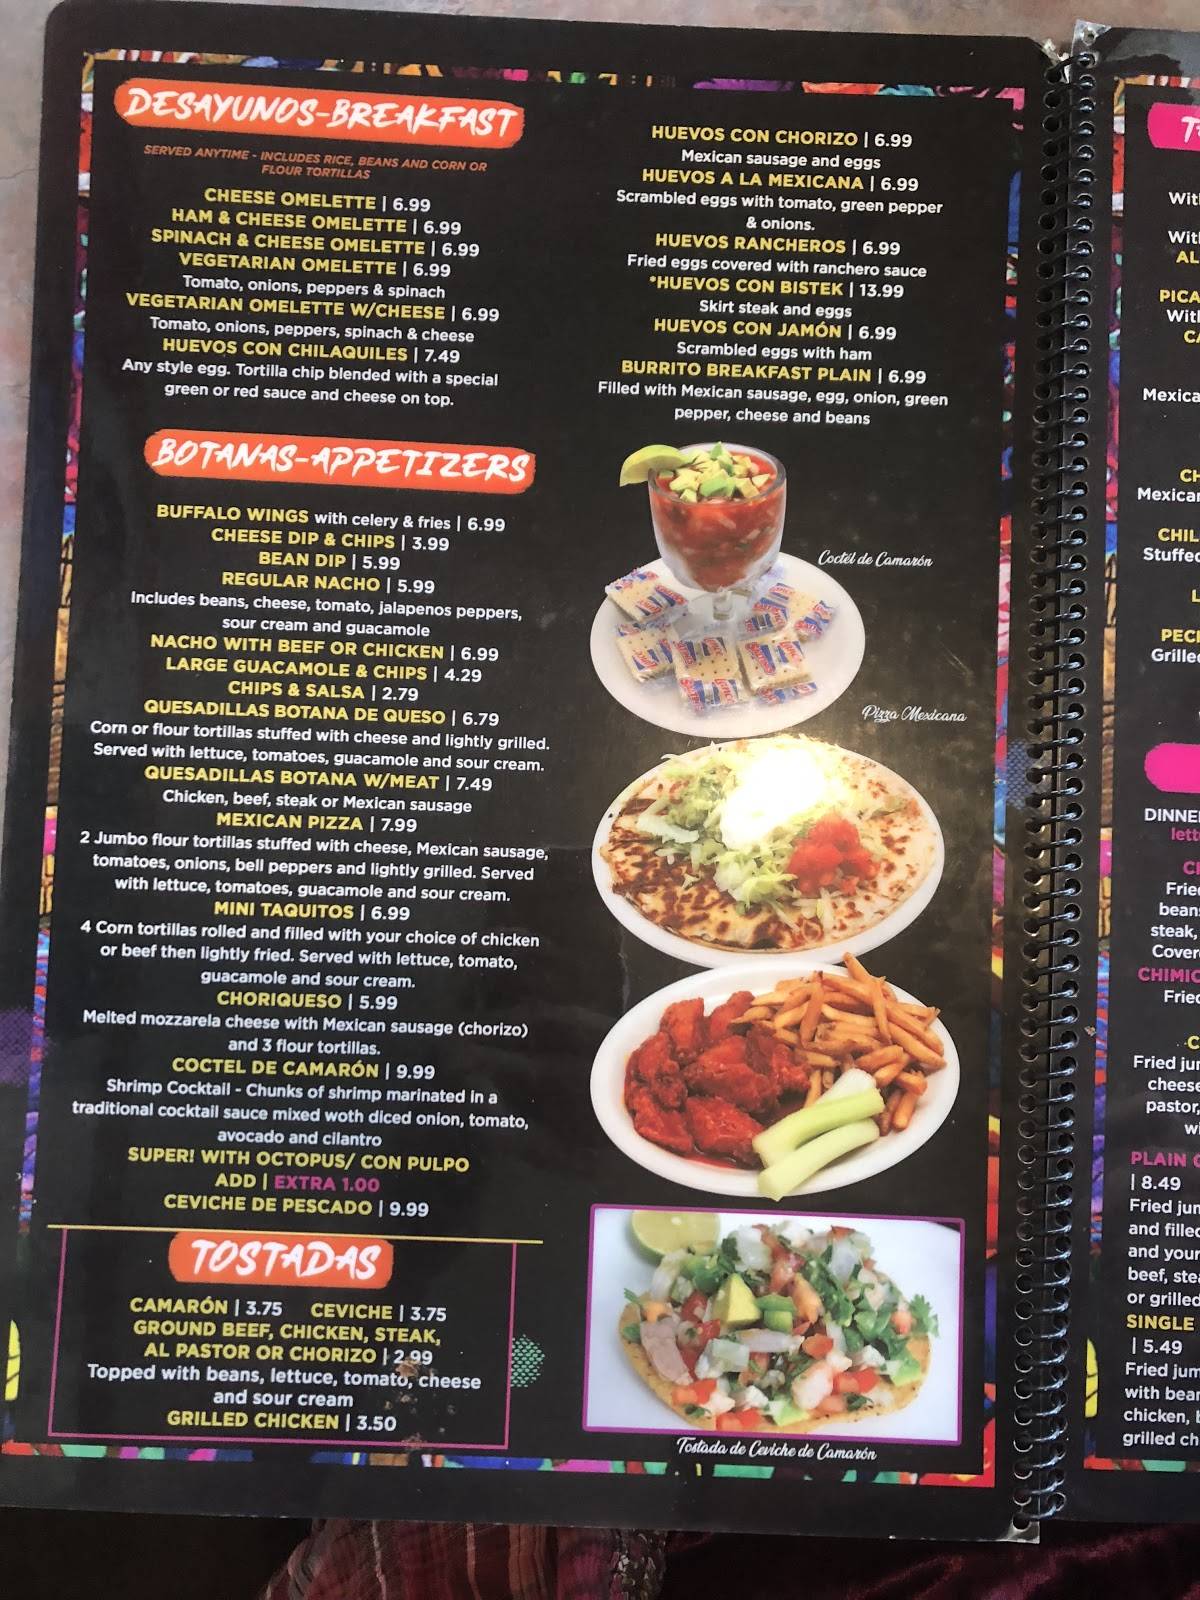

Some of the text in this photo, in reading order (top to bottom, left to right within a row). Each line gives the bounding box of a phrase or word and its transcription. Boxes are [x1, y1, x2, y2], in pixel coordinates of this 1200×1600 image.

[652, 125, 912, 147] HUEVOS CON CHORIZO 6.99
[144, 144, 487, 171] SERVED ANYTIME INCLUDES RICE, BEANS AND CORN OR
[261, 164, 371, 179] FLOUR TORTILLAS
[204, 188, 431, 212] CHEESE OMELETTE 6.99
[151, 228, 479, 257] SPINACH & CHEESE OMELETTE 6.99
[736, 279, 774, 293] CON
[780, 281, 843, 295] BISTEK
[860, 284, 904, 298] 13.99
[126, 293, 499, 322] VEGETARIAN OMELETTE W/CHEESE 6.99
[654, 318, 896, 340] HUEVOS CON JAMÓN 6.99
[163, 338, 460, 363] HUEVOS CON CHILAQUILES 7.49
[622, 360, 926, 384] BURRITO BREAKFAST PLAIN 6.99
[675, 408, 870, 425] pepper, cheese and beans
[157, 504, 505, 532] BUFFALO WINGS with celery & fries 6.99
[259, 551, 400, 570] BEAN DIP 5.99
[857, 552, 873, 565] de
[875, 551, 933, 567] Camarón
[222, 572, 435, 594] REGULAR NACHO 5.99
[131, 591, 522, 621] Includes beans, cheese, tomato, jalapenos peppers,
[166, 657, 482, 682] LARGE GUACAMOLE & CHIPS 4.29
[144, 699, 499, 726] QUESADILLAS BOTANA DE QUESO 6.79
[861, 705, 967, 723] Pizza Mexicana
[216, 812, 417, 832] MEXICAN PIZZA 7.99
[214, 901, 410, 921] MINI TAQUITOS 6.99
[1150, 924, 1198, 940] steak,
[217, 991, 398, 1010] CHORIQUESO 5.99
[83, 1009, 528, 1038] Melted mozzarela cheese with Mexican sausage (chorizo)
[172, 1057, 435, 1080] COCTEL DE CAMARÓN 9.99
[1133, 1054, 1176, 1070] Fried
[1146, 1100, 1200, 1116] pastor,
[128, 1147, 469, 1172] SUPER! WITH OCTOPUS/ CON PULPO
[1130, 1151, 1187, 1168] PLAIN
[215, 1173, 380, 1192] ADD EXTRA 1.00
[1141, 1175, 1181, 1191] 8.49
[164, 1194, 429, 1217] CEVICHE DE PESCADO 9.99
[1129, 1198, 1173, 1214] Fried
[1128, 1222, 1160, 1236] and
[191, 1239, 381, 1280] TOSTADAS
[1128, 1245, 1159, 1259] and
[1127, 1266, 1168, 1285] beef,
[130, 1296, 282, 1316] CAMARÓN 3.75
[1127, 1292, 1146, 1305] or
[311, 1303, 446, 1322] CEVICHE 3.75
[1126, 1314, 1195, 1331] SINGLE
[1143, 1338, 1183, 1355] 5.49
[1125, 1361, 1168, 1377] Fried
[1124, 1385, 1160, 1400] with
[167, 1410, 397, 1431] GRILLED CHICKEN 3.50
[1123, 1408, 1190, 1426] chicken,
[677, 1437, 877, 1460] Tostada de Ceviche de Camarón
[1122, 1431, 1176, 1447] grilled
